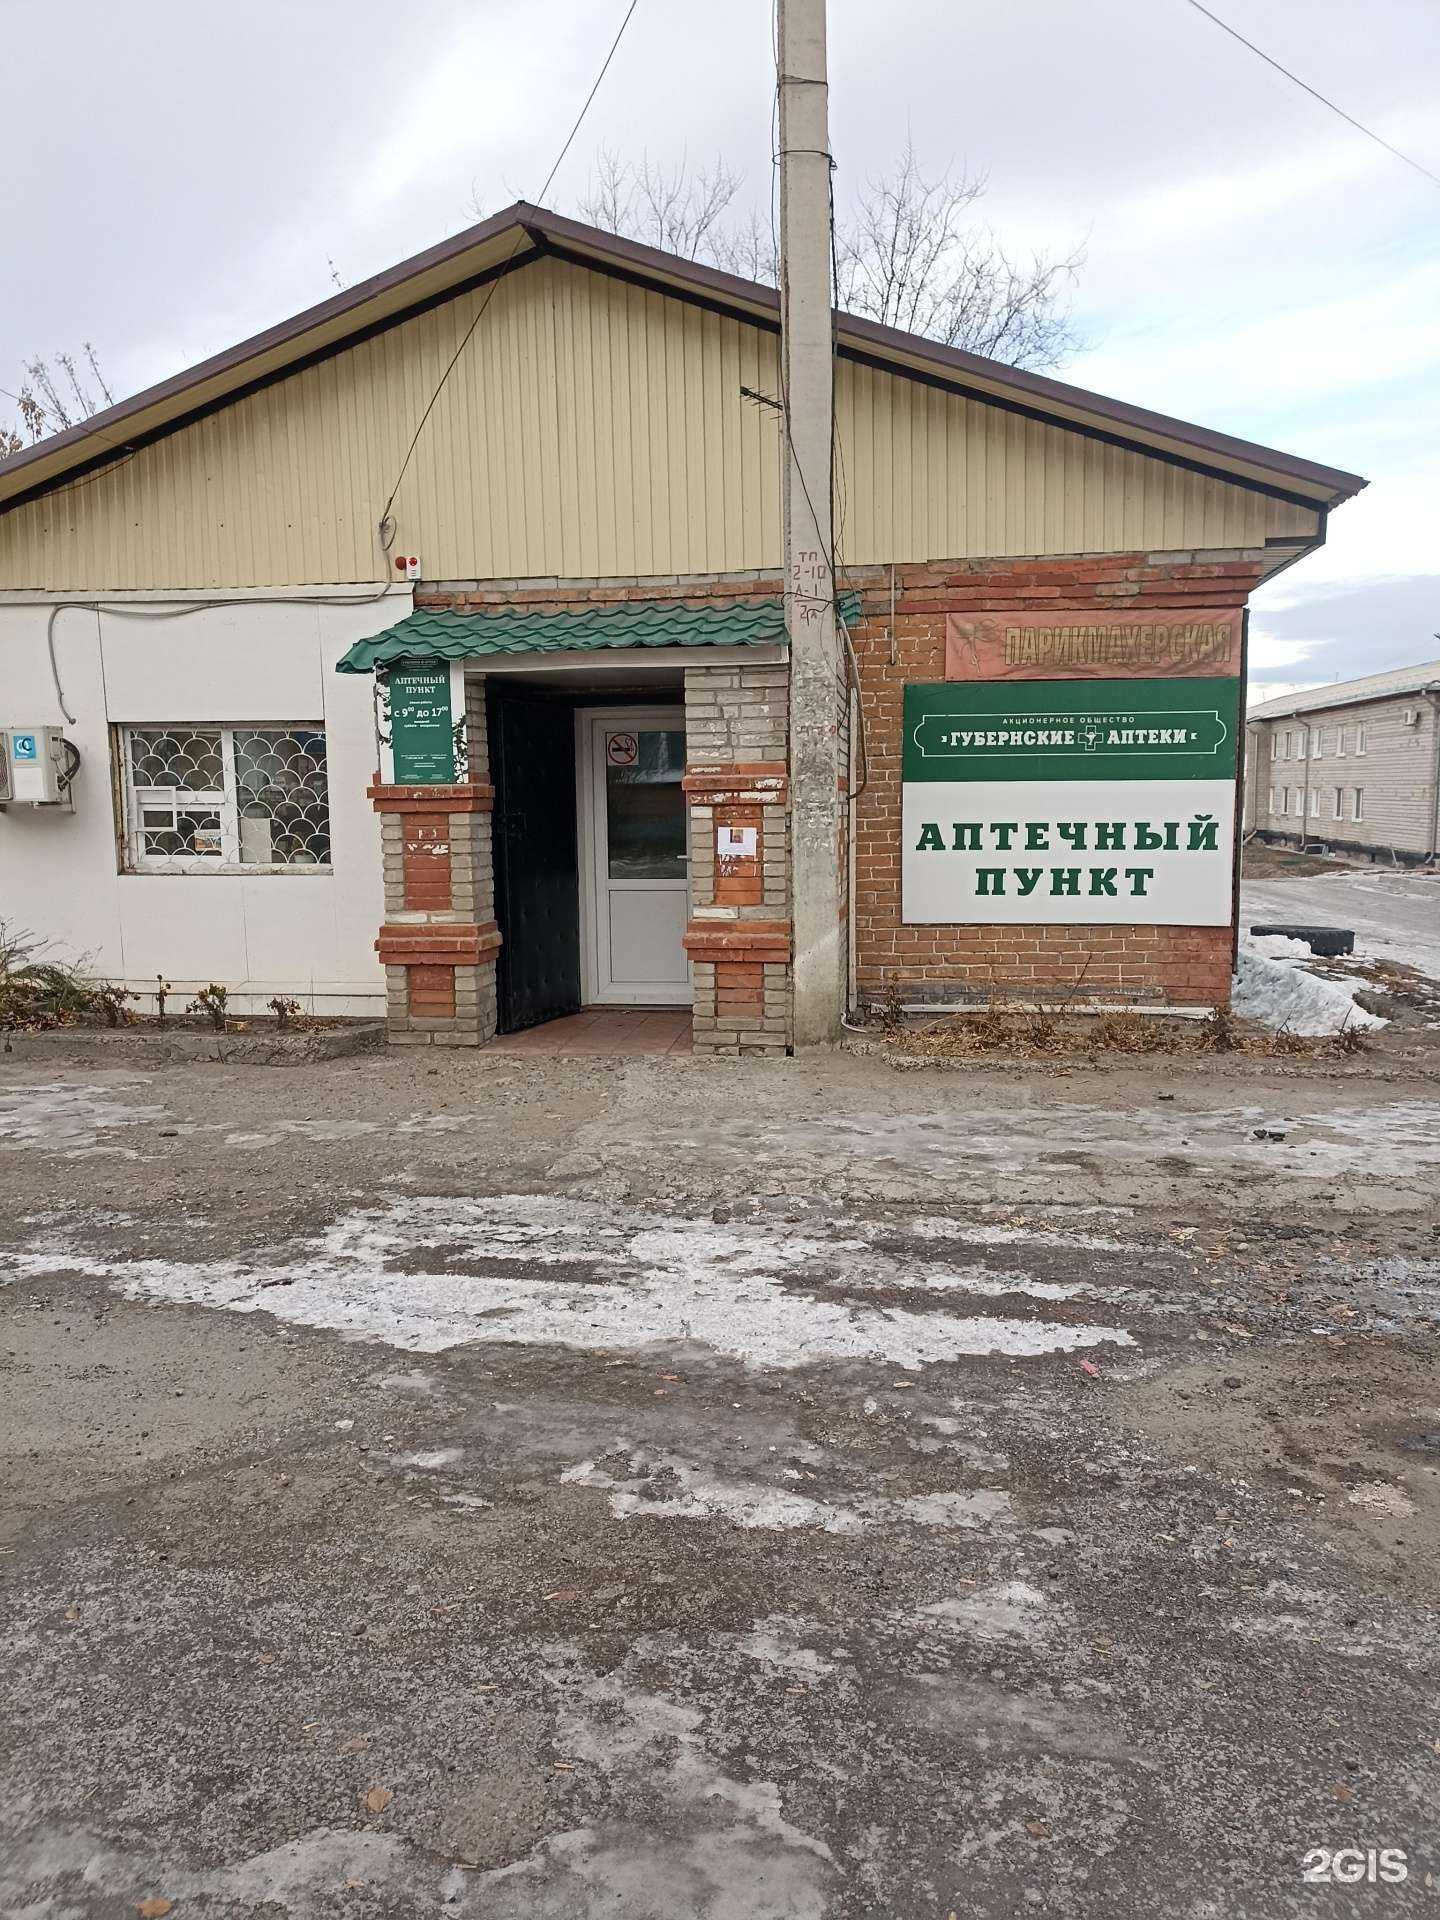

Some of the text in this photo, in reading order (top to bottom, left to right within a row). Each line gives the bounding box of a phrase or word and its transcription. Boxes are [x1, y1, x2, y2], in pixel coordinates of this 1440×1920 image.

[793, 565, 826, 580] 2-10
[1004, 624, 1232, 666] ПАРИКМАХЕРСКАЯ
[394, 674, 446, 685] АПТЕЧНЫЙ
[405, 686, 436, 694] ПУНКТ
[416, 709, 429, 718] до
[1002, 716, 1135, 725] АКЦИОНЕРНОЕ ОБЩЕСТВО
[950, 729, 1187, 746] ГУБЕРНСКИЕ АПТЕКИ
[915, 814, 1219, 851] АПТЕЧНЫЙ
[974, 867, 1154, 897] ПУНКТ
